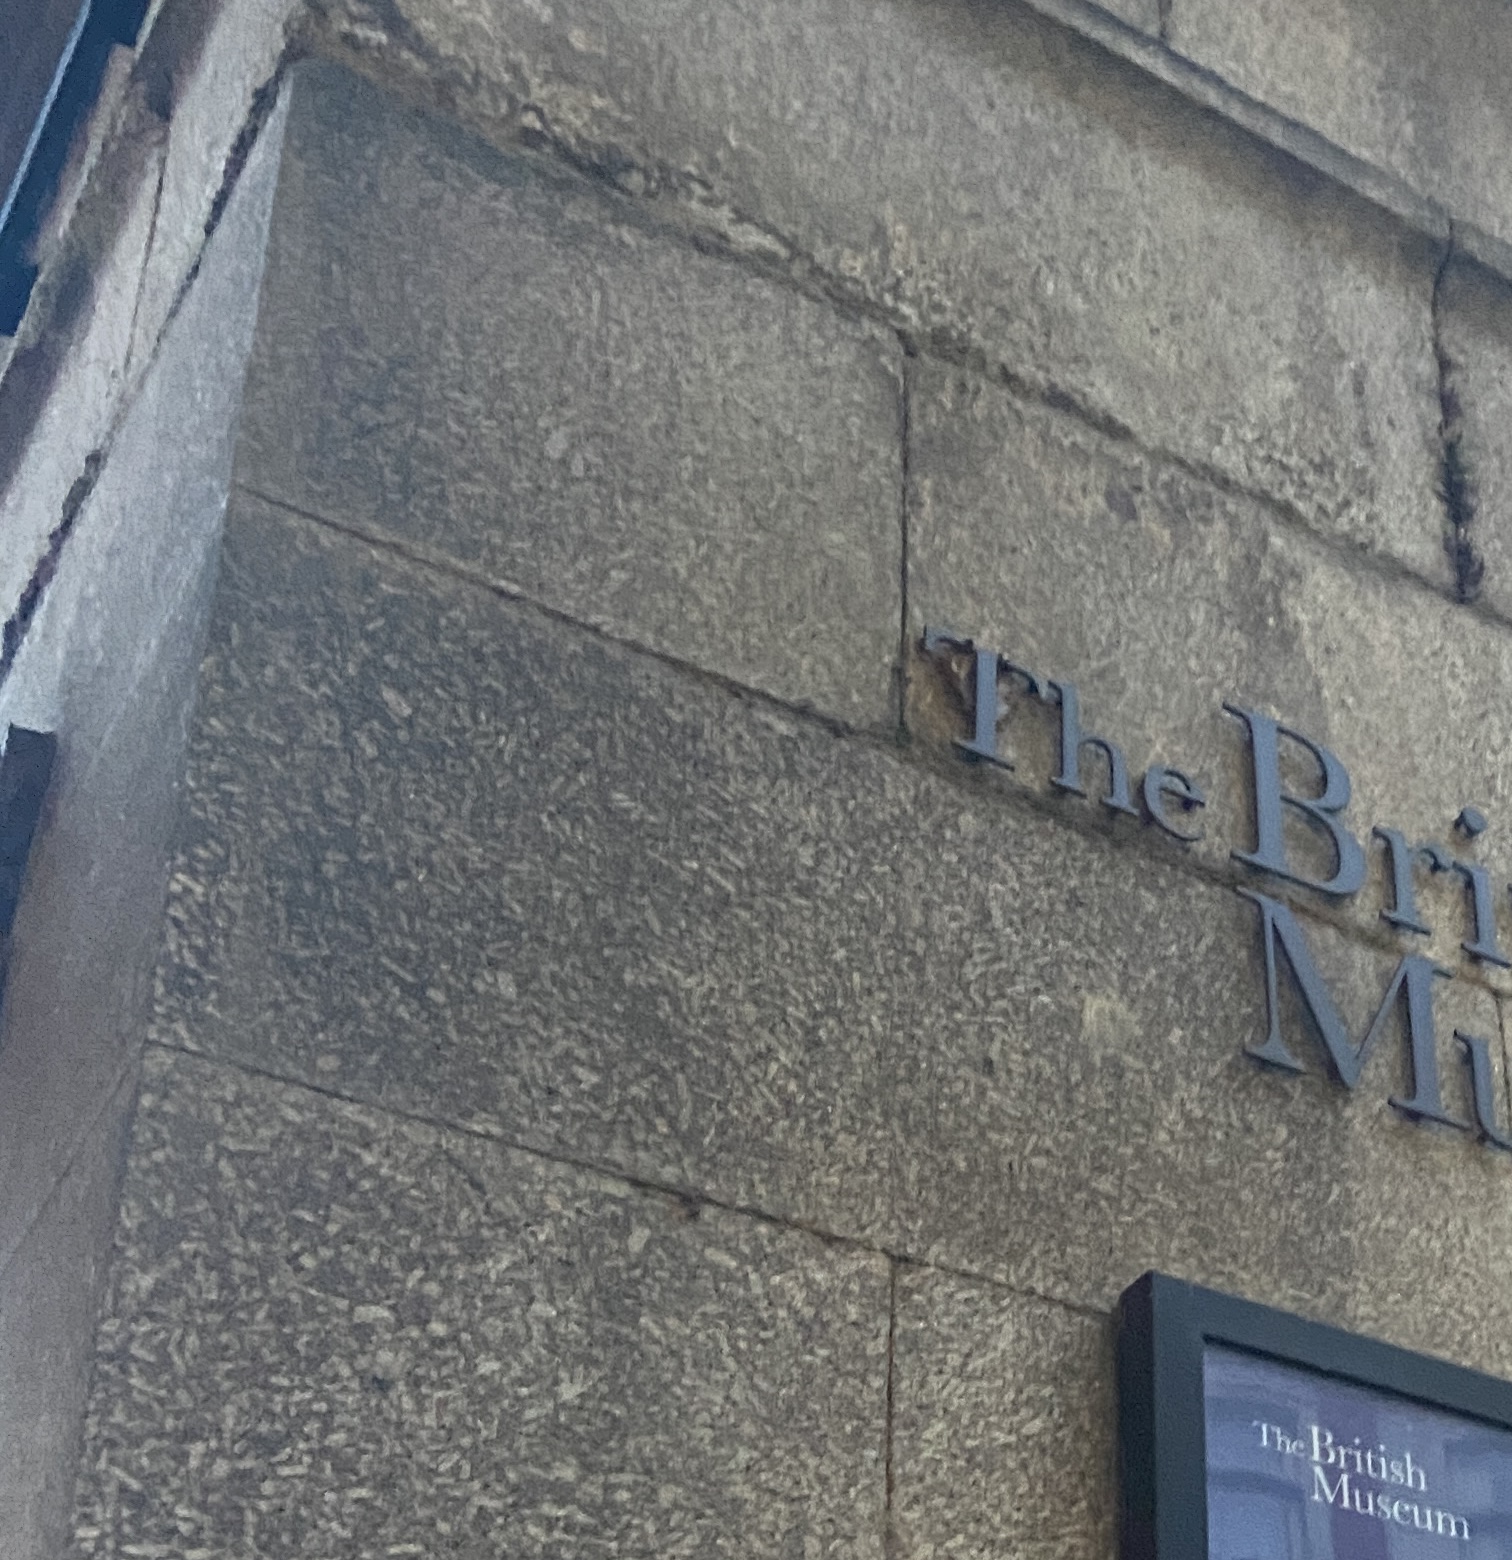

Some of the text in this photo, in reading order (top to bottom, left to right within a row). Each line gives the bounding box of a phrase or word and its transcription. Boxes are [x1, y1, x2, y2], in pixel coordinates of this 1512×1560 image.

[922, 626, 1206, 844] The
[1253, 1420, 1429, 1493] The British
[1310, 1465, 1472, 1541] Museum
